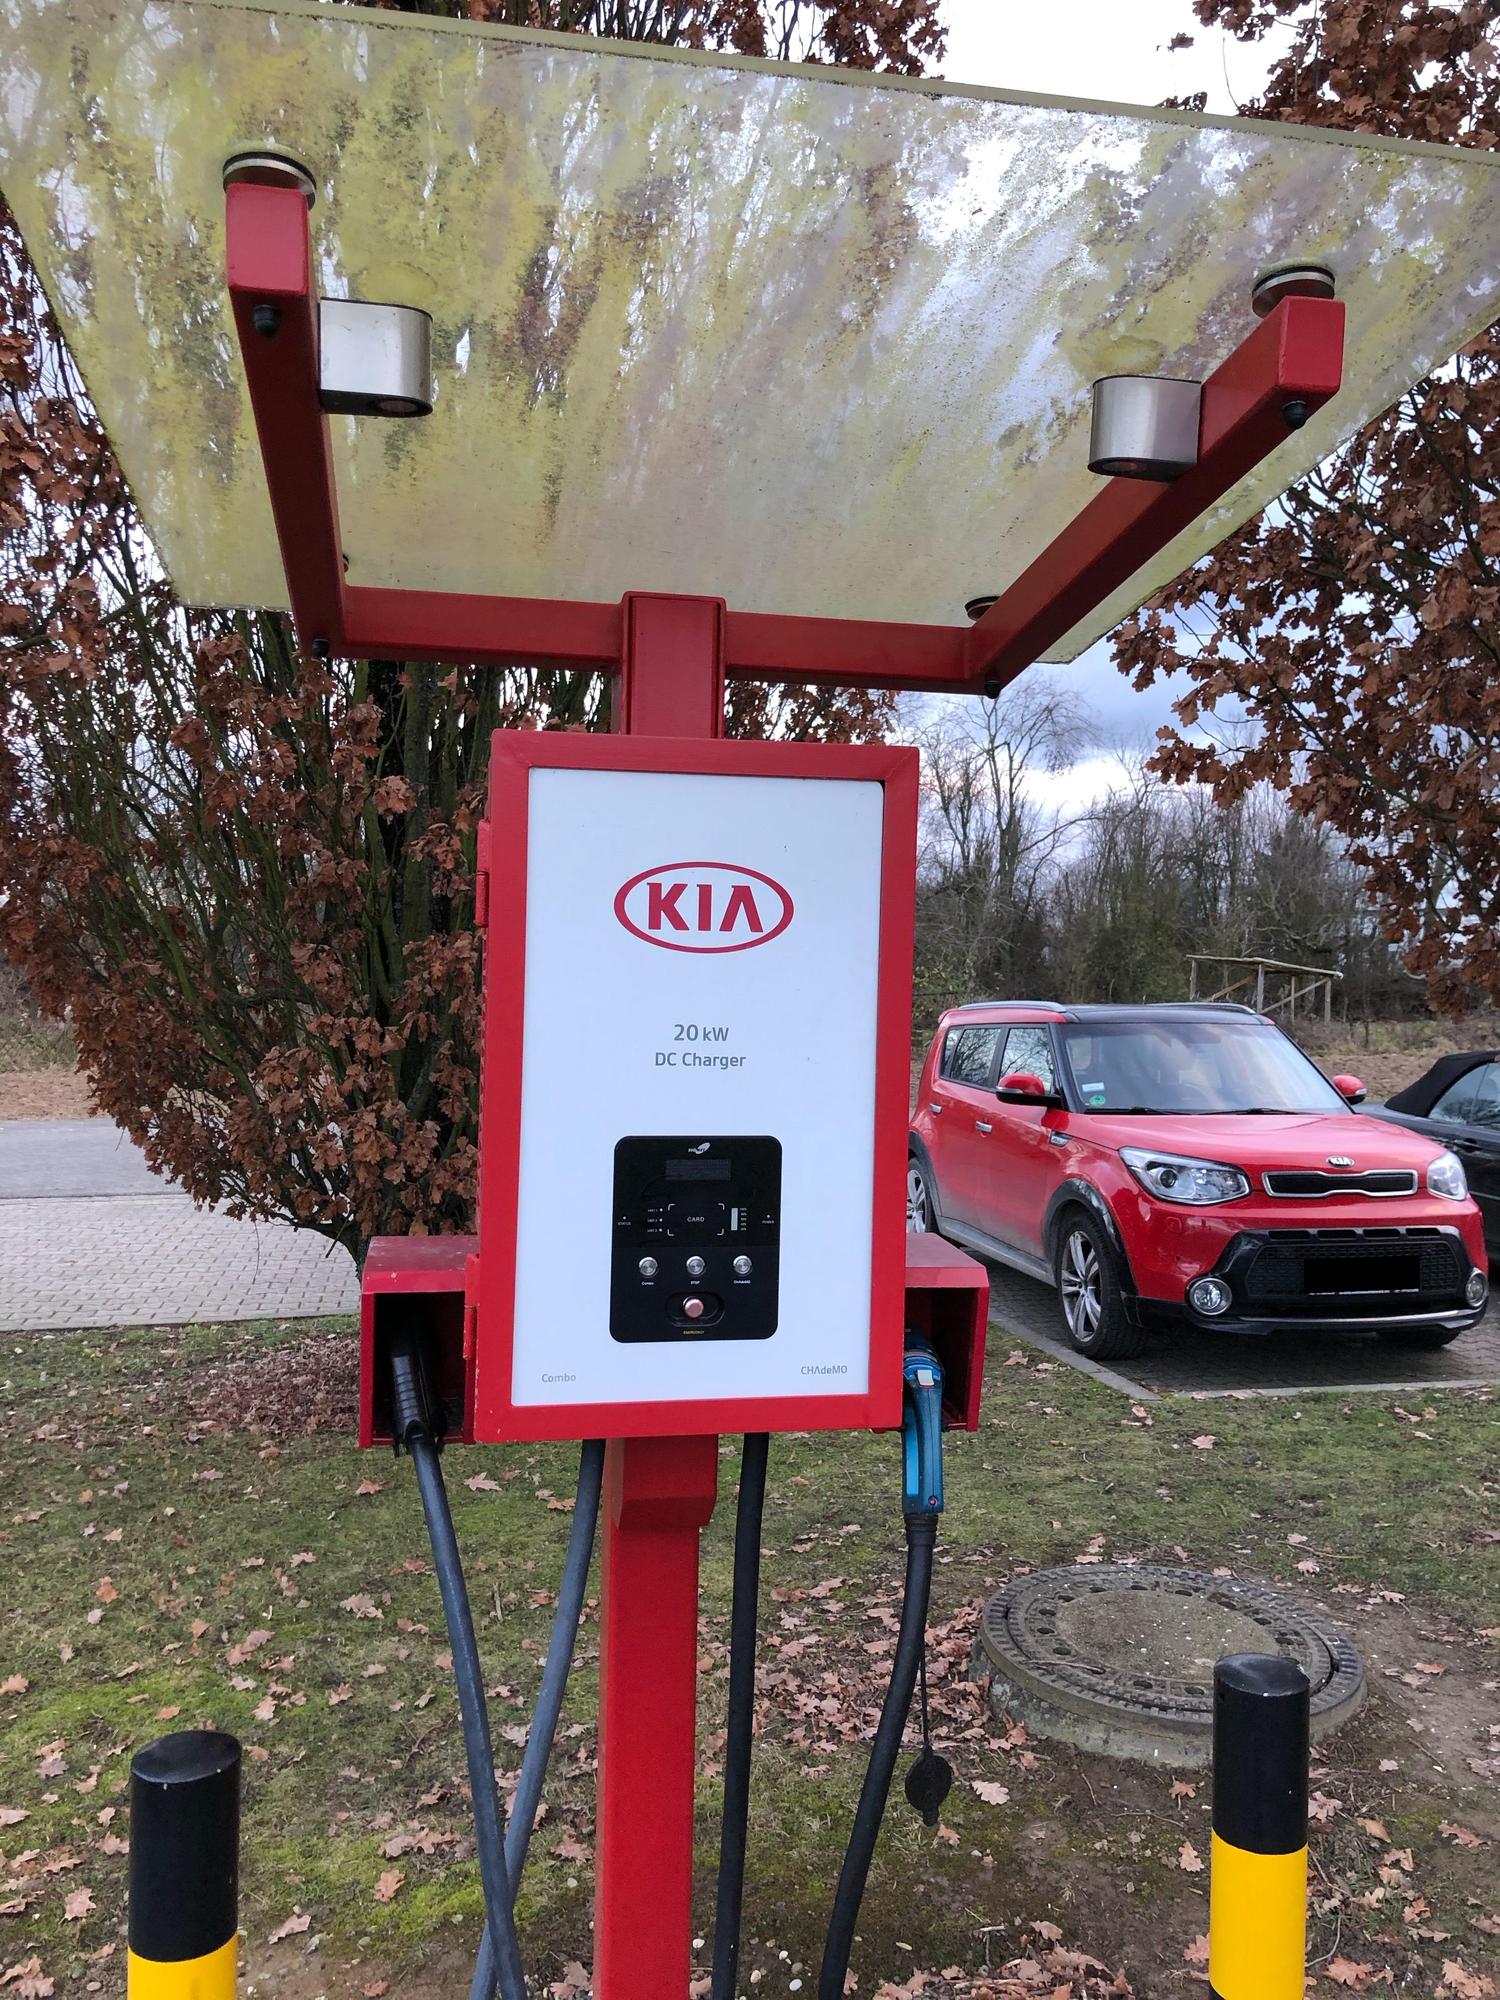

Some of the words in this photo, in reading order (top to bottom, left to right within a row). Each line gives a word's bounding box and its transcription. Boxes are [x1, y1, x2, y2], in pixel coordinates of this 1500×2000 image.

[646, 882, 764, 933] KIA
[673, 1023, 699, 1042] 20
[702, 1026, 730, 1042] kW
[655, 1051, 677, 1067] DC
[682, 1052, 747, 1071] Charger
[541, 1373, 577, 1383] Combo
[800, 1365, 848, 1375] CHAdeMO
